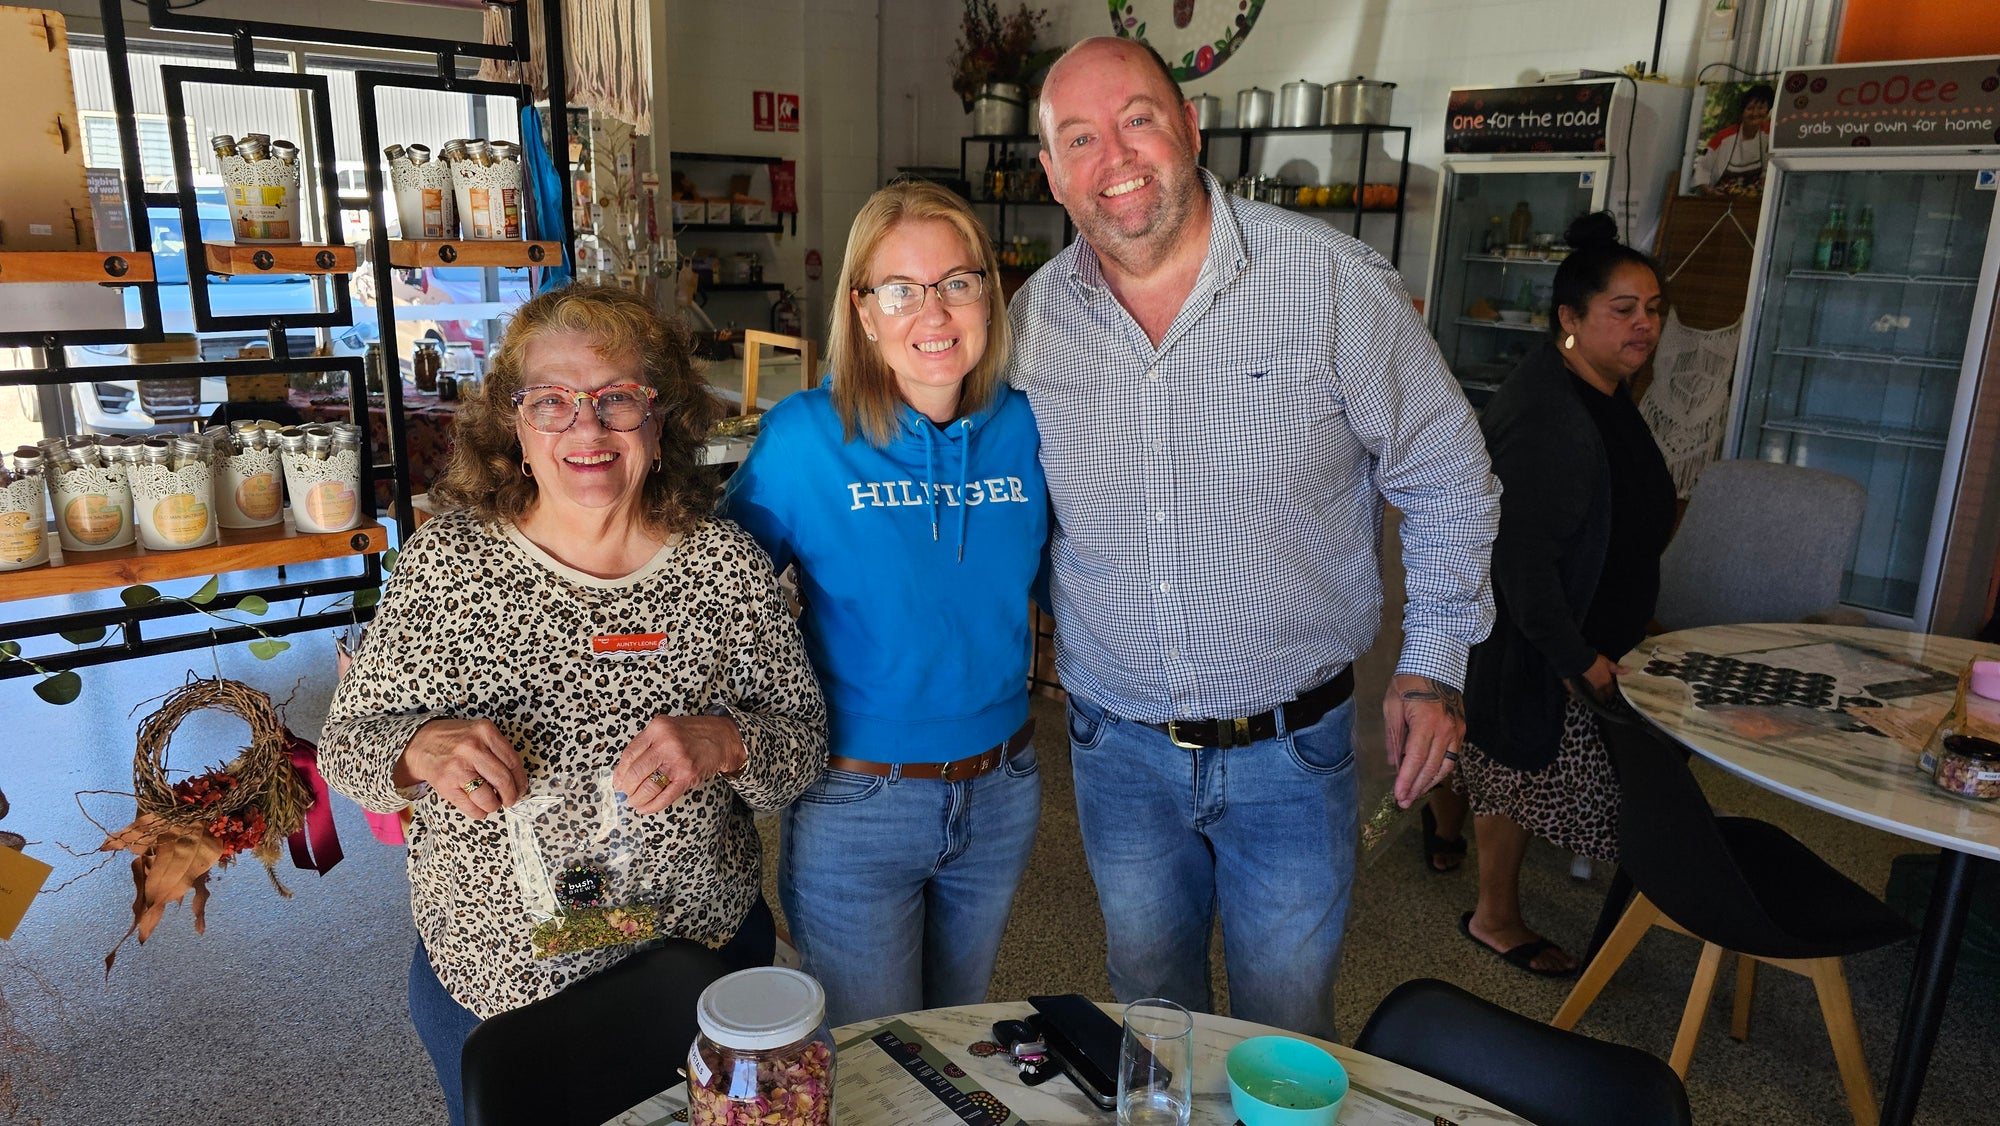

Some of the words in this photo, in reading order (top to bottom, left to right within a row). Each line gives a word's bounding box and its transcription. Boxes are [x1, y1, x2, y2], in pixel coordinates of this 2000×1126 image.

[1453, 115, 1484, 130] one
[1487, 112, 1516, 129] for
[1518, 109, 1552, 128] the
[1556, 106, 1600, 127] road
[1798, 120, 1832, 138] grab
[1836, 121, 1870, 138] your
[1874, 120, 1908, 133] own
[1912, 119, 1938, 132] for
[1945, 118, 1992, 131] home
[847, 476, 1029, 511] HILFIGER
[568, 879, 594, 890] bush
[568, 885, 596, 895] BREWS
